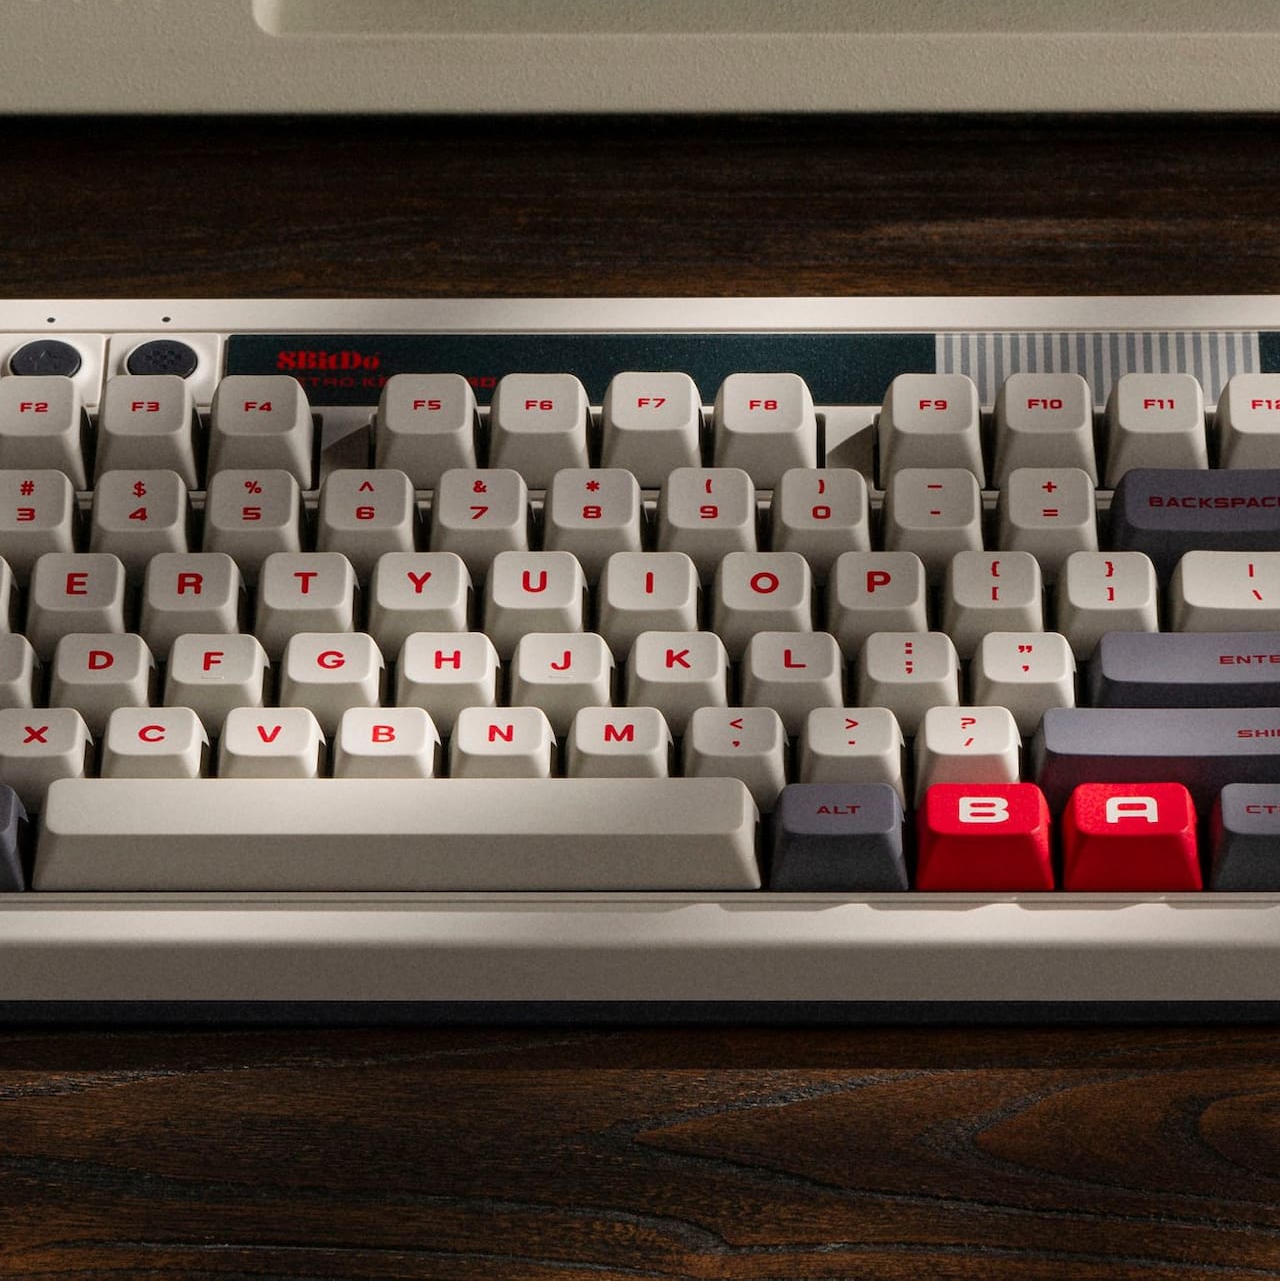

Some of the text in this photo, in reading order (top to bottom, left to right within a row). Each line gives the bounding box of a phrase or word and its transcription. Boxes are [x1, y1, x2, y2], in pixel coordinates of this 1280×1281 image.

[276, 349, 384, 371] 8BitDo
[19, 402, 48, 412] F2
[131, 401, 160, 412] F3
[244, 401, 272, 412] F4
[413, 399, 441, 410] F5
[525, 400, 553, 411] F6
[637, 397, 665, 408] F7
[748, 399, 778, 411] F8
[918, 399, 948, 410] F9
[1027, 398, 1063, 410] F10
[1143, 398, 1175, 410] F11
[21, 481, 34, 495] #
[134, 481, 145, 497] $
[244, 480, 262, 494] %
[473, 480, 486, 494] &
[1042, 481, 1057, 492] +
[19, 508, 35, 521] 3
[129, 507, 147, 521] 4
[243, 507, 261, 520] 5
[356, 507, 374, 519] 6
[471, 505, 488, 520] 7
[583, 506, 601, 519] 8
[700, 505, 718, 518] 9
[1044, 508, 1058, 517] =
[991, 560, 999, 577] {
[1105, 561, 1114, 578] }
[66, 572, 86, 595] E
[177, 573, 203, 594] R
[295, 571, 316, 594] T
[407, 572, 431, 594] Y
[522, 571, 547, 593] U
[646, 572, 654, 594] I
[750, 572, 779, 594] O
[867, 571, 890, 592] P
[991, 587, 998, 600] [
[1108, 587, 1115, 602] ]
[88, 650, 114, 670] D
[203, 651, 222, 672] F
[317, 651, 345, 670] G
[434, 651, 461, 669] H
[550, 650, 572, 671] J
[666, 649, 689, 668] K
[783, 649, 805, 669] L
[961, 717, 976, 727] ?
[24, 726, 48, 744] X
[138, 725, 164, 742] C
[257, 725, 281, 744] V
[372, 725, 395, 742] B
[488, 725, 513, 742] N
[604, 725, 634, 741] M
[817, 804, 858, 815] ALT
[959, 797, 1009, 823] B
[1105, 796, 1158, 823] A
